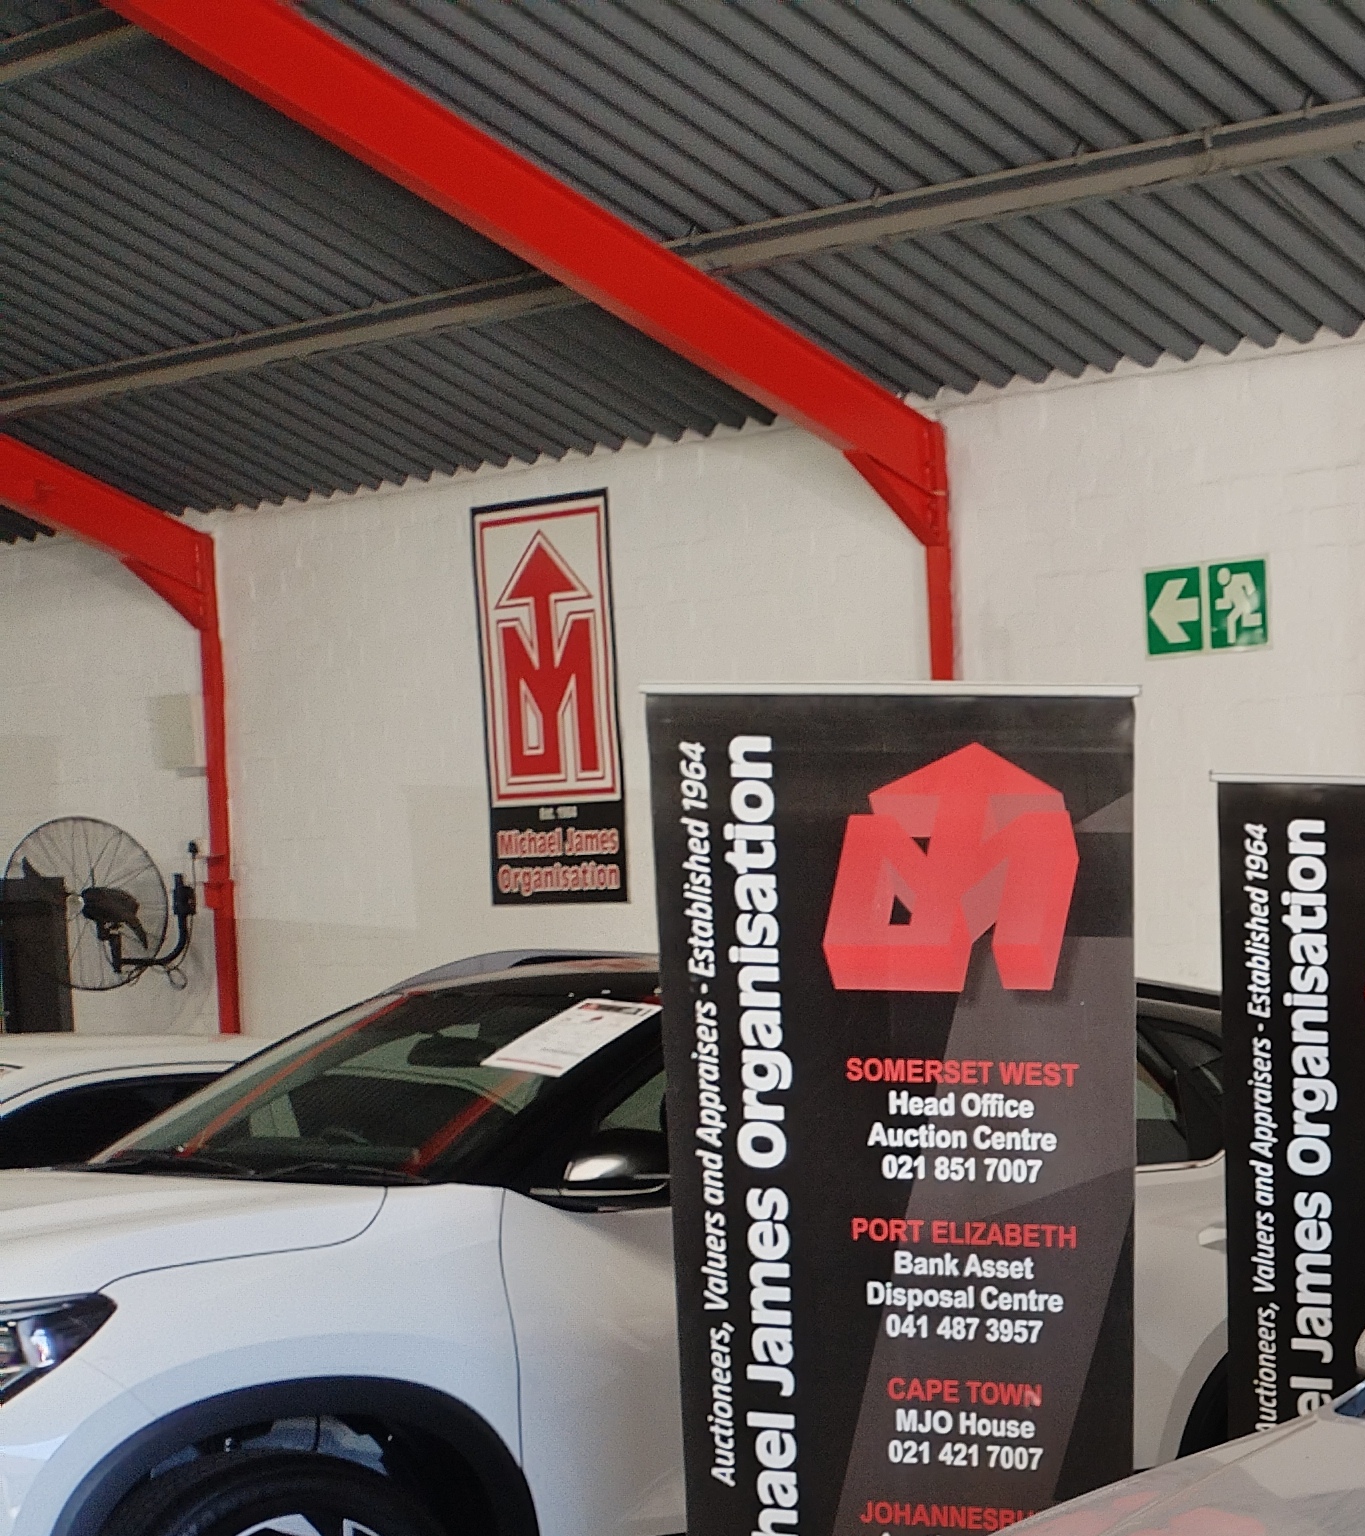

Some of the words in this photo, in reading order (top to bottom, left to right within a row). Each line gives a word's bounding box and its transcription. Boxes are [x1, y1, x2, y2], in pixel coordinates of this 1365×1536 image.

[678, 741, 708, 812] 1964
[497, 827, 563, 859] Michael
[565, 827, 620, 856] James
[1244, 823, 1269, 884] 1964
[497, 861, 621, 897] Organisation
[680, 817, 717, 979] Established
[722, 734, 794, 1170] Organisation
[1244, 885, 1272, 1018] Established
[1281, 818, 1338, 1176] Organisation
[690, 1000, 728, 1149] Appraisers
[846, 1057, 993, 1084] SOMERSET
[999, 1060, 1080, 1088] WEST
[888, 1091, 955, 1117] Head
[961, 1092, 1035, 1119] Office
[1248, 1037, 1279, 1160] Appraisers
[867, 1121, 968, 1149] Auction
[973, 1124, 1058, 1151] Centre
[696, 1150, 726, 1207] and
[881, 1154, 926, 1180] 021
[934, 1155, 976, 1182] 851
[983, 1156, 1042, 1183] 7007
[1250, 1160, 1276, 1206] and
[851, 1217, 924, 1244] PORT
[932, 1220, 1077, 1250] ELIZABETH
[1251, 1206, 1276, 1293] Valuers
[701, 1210, 730, 1312] Valuers
[893, 1251, 959, 1277] Bank
[964, 1252, 1034, 1281] Asset
[1290, 1191, 1334, 1363] James
[746, 1186, 798, 1398] James
[866, 1281, 975, 1313] Disposal
[980, 1284, 1064, 1314] Centre
[885, 1315, 931, 1340] 041
[936, 1316, 979, 1342] 487
[984, 1318, 1044, 1344] 3957
[706, 1320, 736, 1487] Auctioneers,
[888, 1378, 960, 1404] CAPE
[966, 1380, 1043, 1408] TOWN
[895, 1409, 954, 1435] MJO
[960, 1411, 1036, 1440] House
[888, 1438, 931, 1465] 021
[937, 1440, 980, 1467] 421
[986, 1442, 1044, 1470] 7007
